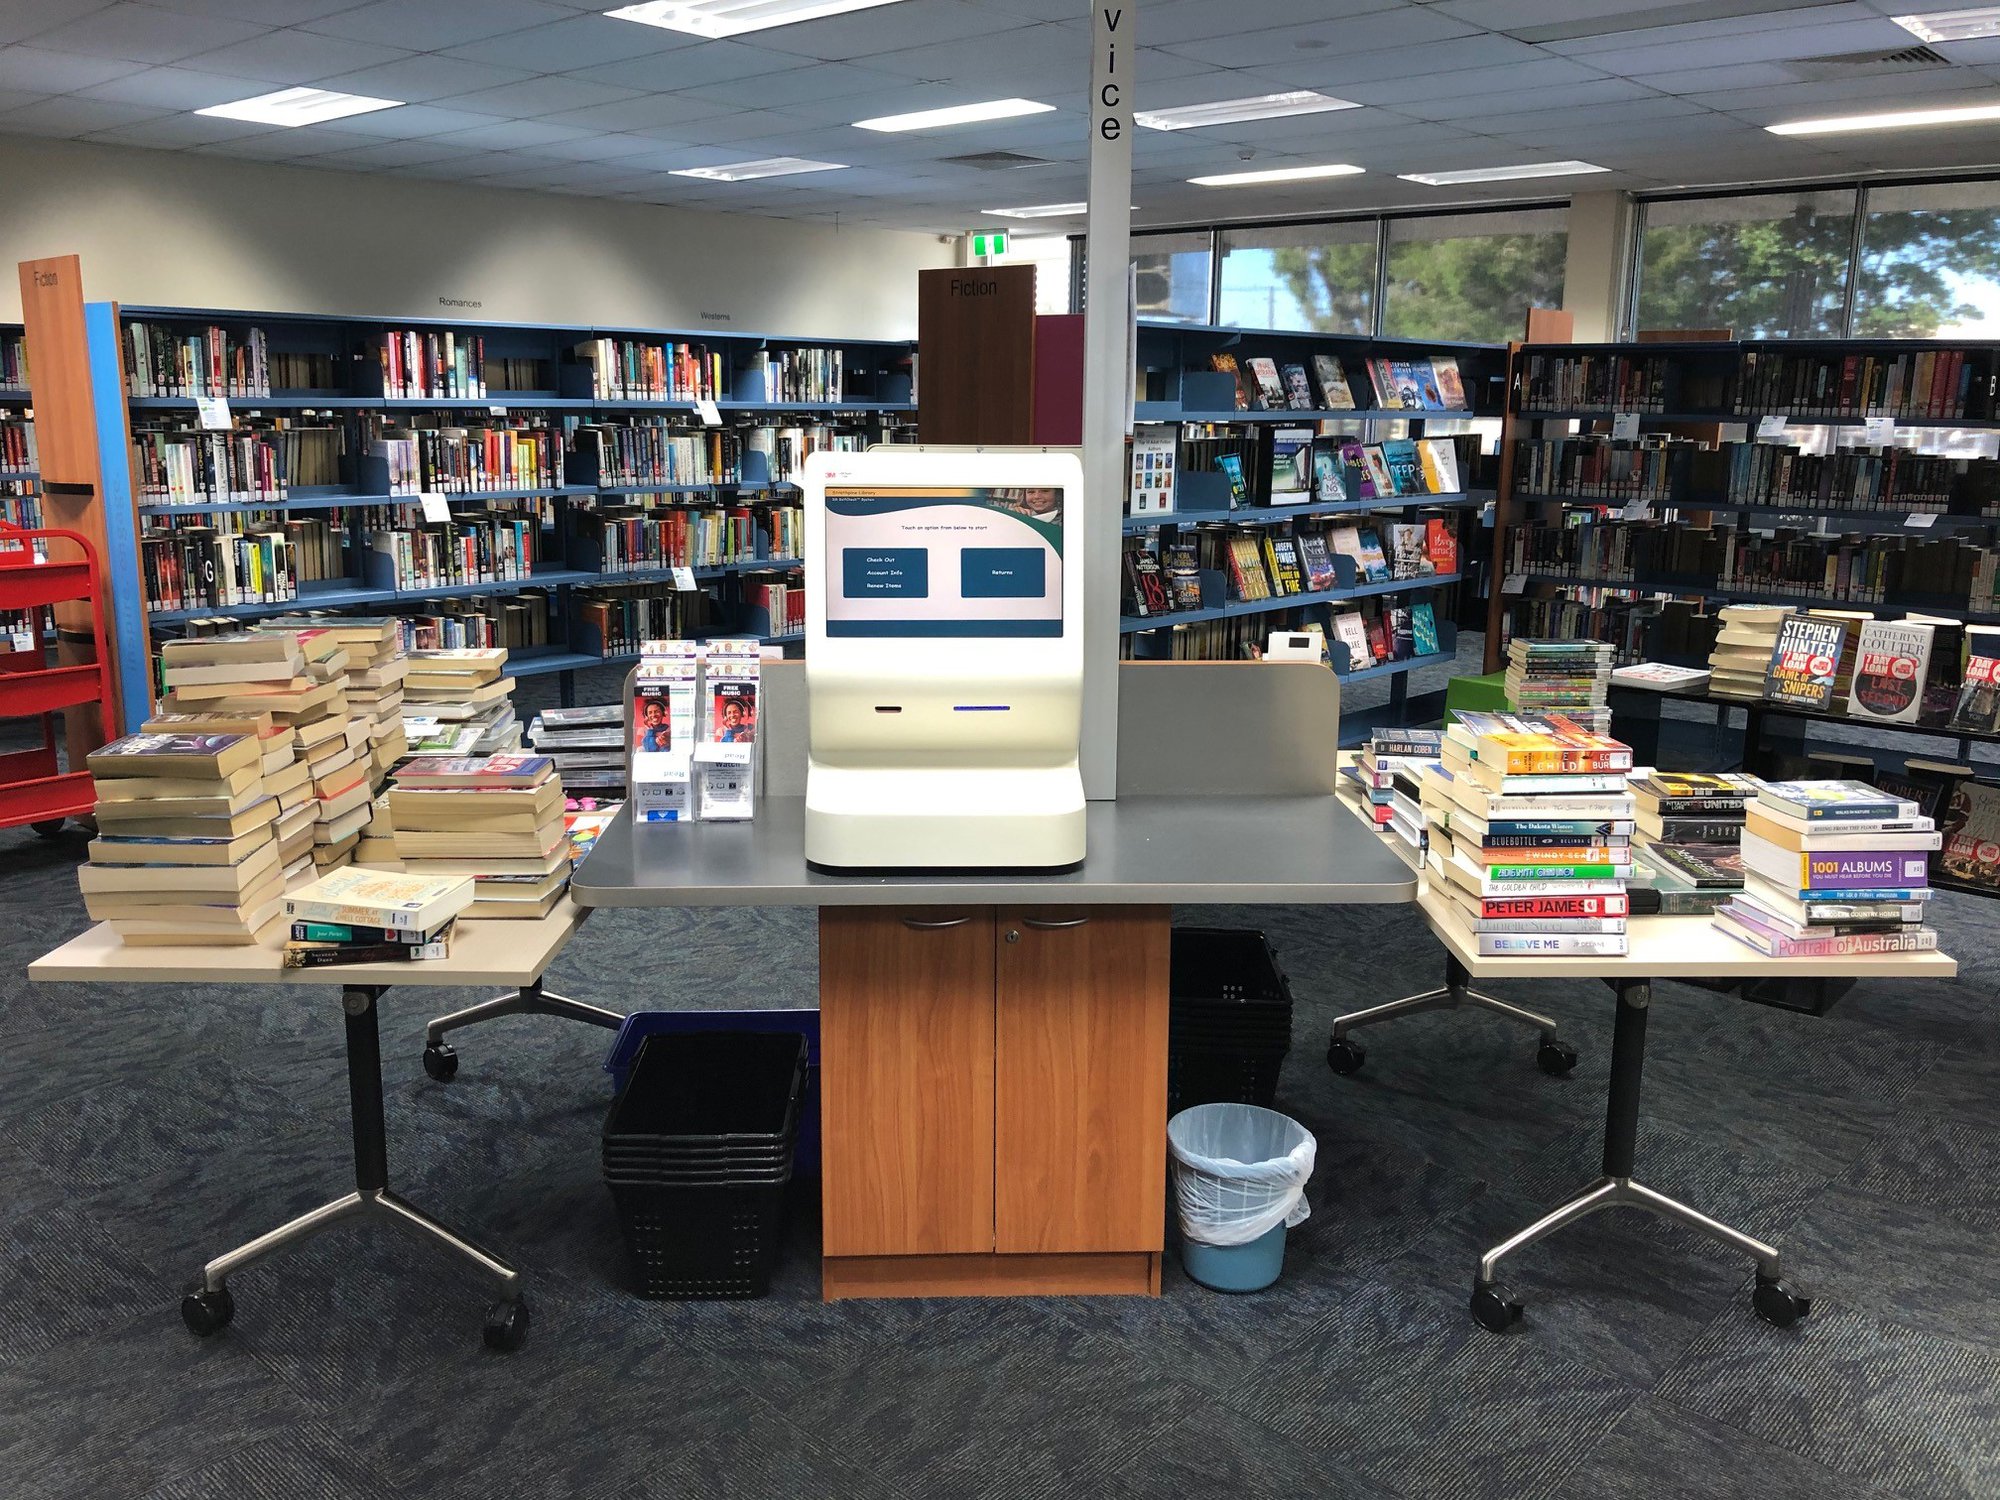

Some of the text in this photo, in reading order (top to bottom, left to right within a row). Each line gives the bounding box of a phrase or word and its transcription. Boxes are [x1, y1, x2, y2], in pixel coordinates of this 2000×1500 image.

[1101, 9, 1122, 140] vice
[33, 271, 58, 287] Fiction
[950, 279, 997, 297] Fiction
[439, 297, 482, 309] Romances
[700, 311, 731, 321] Westerns
[1513, 372, 1521, 391] A
[1990, 375, 1997, 396] B
[1390, 464, 1415, 478] DEEP
[1274, 541, 1294, 552] JOSEPH
[1275, 551, 1298, 564] FINDER
[1285, 580, 1302, 593] FIRE
[1344, 627, 1359, 637] BELL
[1783, 621, 1841, 643] STEPHEN
[1864, 628, 1927, 643] CATHERINE
[1778, 637, 1836, 658] HUNTER
[1862, 638, 1925, 656] COULTER
[1785, 652, 1810, 662] 7 DAY
[1866, 654, 1891, 666] 7 DAY
[1969, 657, 1993, 669] 7 DAY
[1783, 660, 1807, 670] LOAN
[1864, 663, 1889, 675] LOAN
[1773, 665, 1800, 681] GAME
[1800, 674, 1810, 682] OF
[1966, 667, 1991, 679] LOAN
[1782, 680, 1826, 699] SNIPERS
[1861, 690, 1908, 706] SECOND
[1389, 744, 1432, 754] HARLAN COBEN
[1599, 753, 1610, 761] EC
[1537, 761, 1610, 772] CHILD BUR
[1703, 799, 1741, 810] UNITED
[1491, 836, 1537, 846] BLUEBOTTLE
[1958, 834, 1978, 845] DAY
[1532, 851, 1564, 859] WINDY
[1949, 842, 1975, 856] LOAN
[1812, 861, 1839, 873] 1001
[1841, 860, 1893, 873] ALBUMS
[1488, 883, 1499, 891] THE
[1501, 883, 1527, 892] GOLDEN
[341, 906, 370, 916] SUMMER
[1485, 900, 1585, 913] PETER JAMES
[1850, 910, 1900, 918] COUNTRY HOMES
[354, 916, 382, 925] COTTAGE
[1477, 919, 1563, 932] Danielle Steel
[1495, 940, 1540, 949] BELIEVE
[1543, 940, 1560, 949] ME
[1779, 936, 1917, 956] Portrait of Australia
